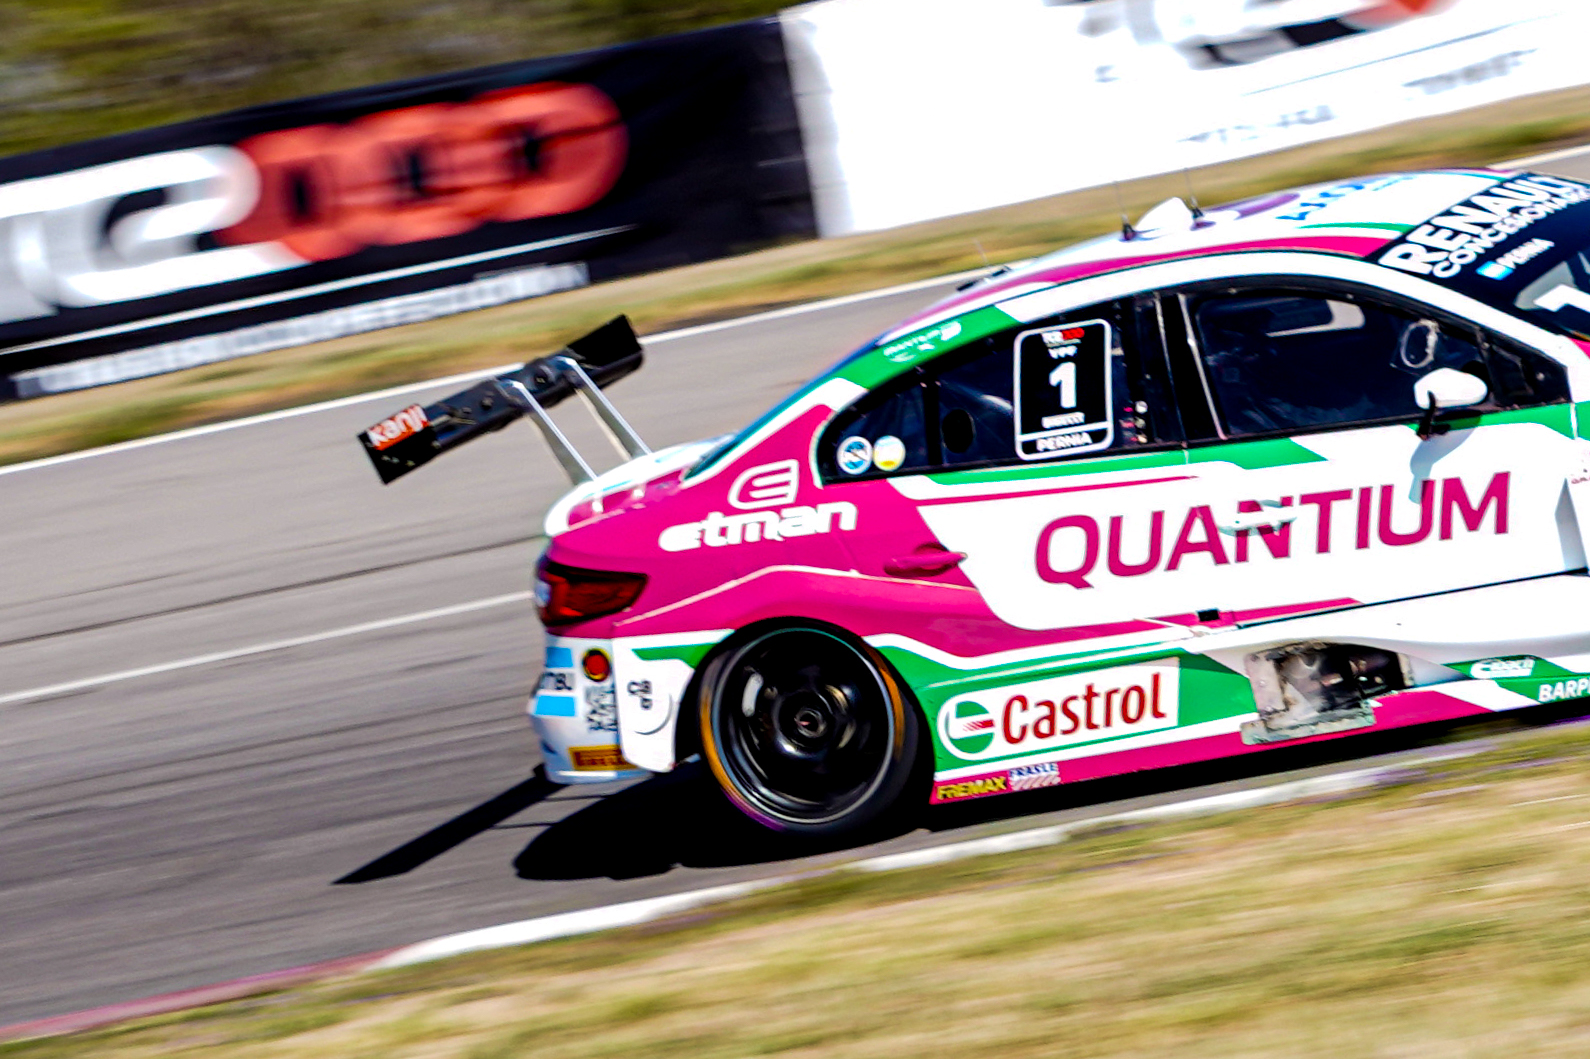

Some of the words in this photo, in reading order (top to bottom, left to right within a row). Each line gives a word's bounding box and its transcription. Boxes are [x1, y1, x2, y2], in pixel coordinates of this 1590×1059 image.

[1377, 176, 1581, 276] RENAULT
[1049, 361, 1077, 409] 1
[1034, 471, 1511, 590] QUANTIUM
[1002, 672, 1167, 745] Castrol
